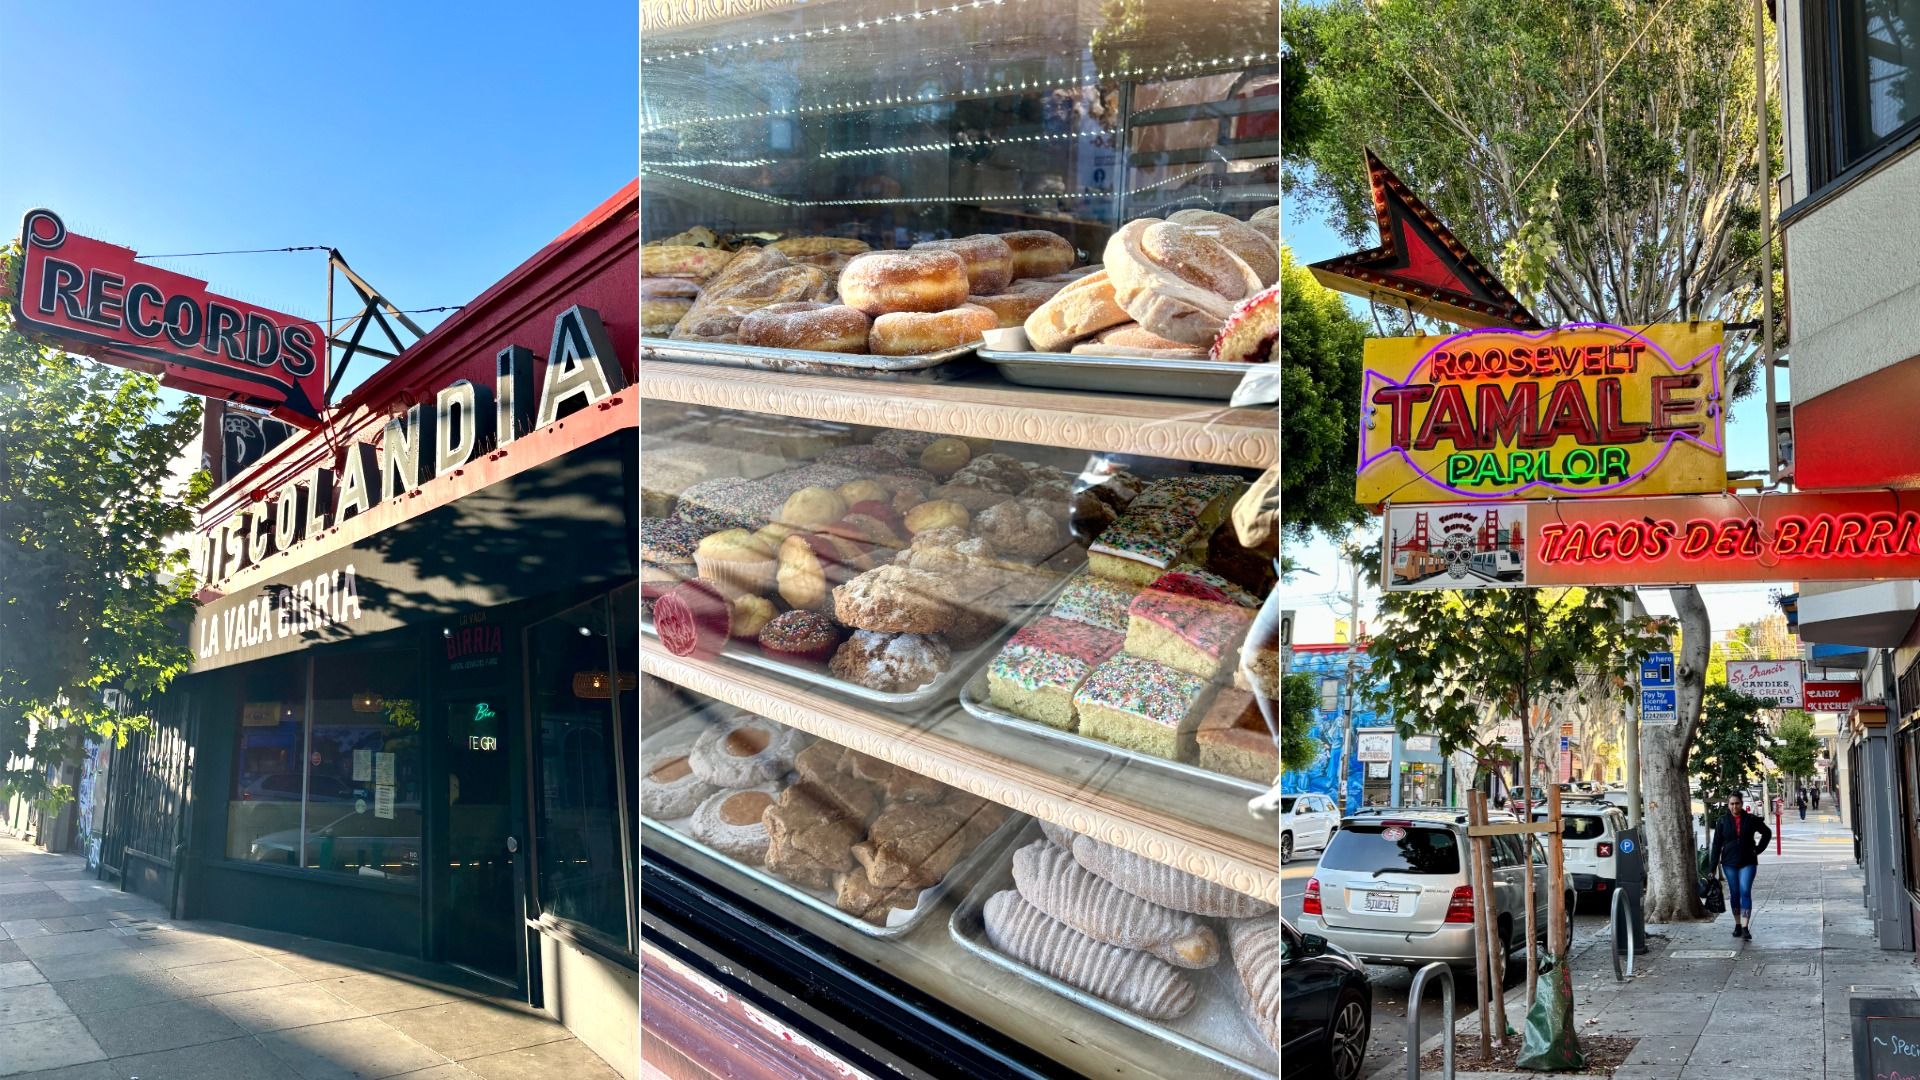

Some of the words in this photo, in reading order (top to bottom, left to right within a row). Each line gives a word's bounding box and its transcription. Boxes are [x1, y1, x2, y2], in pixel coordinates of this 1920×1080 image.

[38, 256, 317, 377] RECORDS
[1429, 341, 1646, 381] ROOSEVELT
[1372, 372, 1705, 452] TAMALE
[1447, 447, 1630, 486] PARLOR
[1683, 518, 1760, 556] DEL
[1774, 514, 1920, 556] BARRI
[200, 614, 219, 659] LA
[224, 594, 273, 652] VACA
[277, 563, 362, 639] BIRRIA
[1643, 691, 1656, 699] Pay
[1657, 691, 1666, 700] by
[1759, 688, 1790, 696] CREAM
[1807, 689, 1841, 698] CANDY
